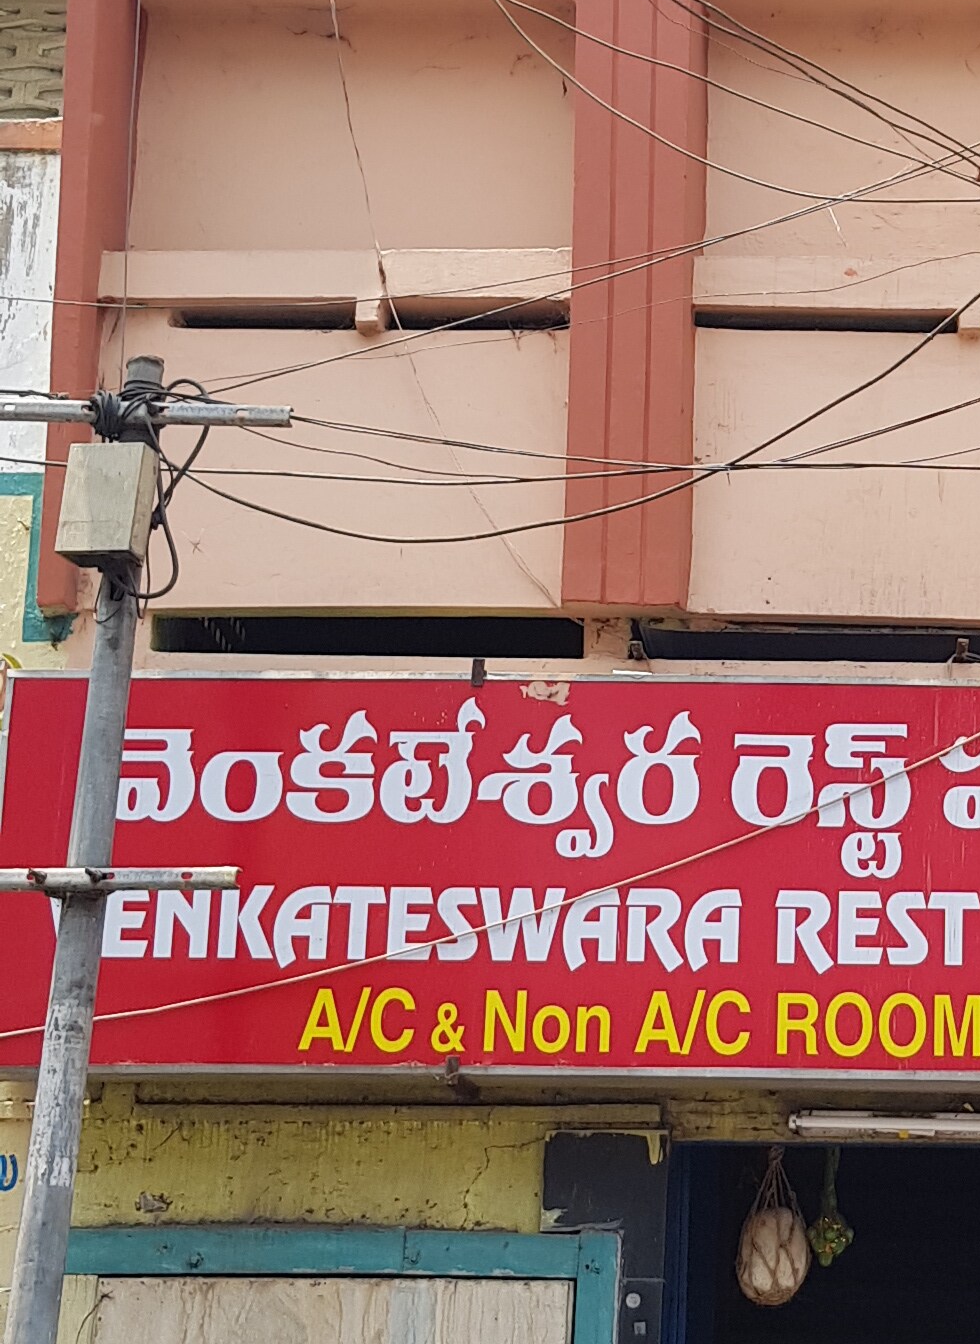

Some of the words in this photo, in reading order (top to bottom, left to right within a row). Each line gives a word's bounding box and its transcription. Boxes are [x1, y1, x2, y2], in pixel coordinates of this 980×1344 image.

[115, 696, 702, 859] వెంకటేశ్వర
[730, 723, 912, 879] రెస్ట్
[49, 888, 742, 973] ENKATESWARA
[775, 889, 980, 975] REST
[298, 987, 416, 1053] A/C
[431, 1002, 465, 1053] &
[483, 990, 611, 1054] Non
[634, 989, 751, 1056] A/C
